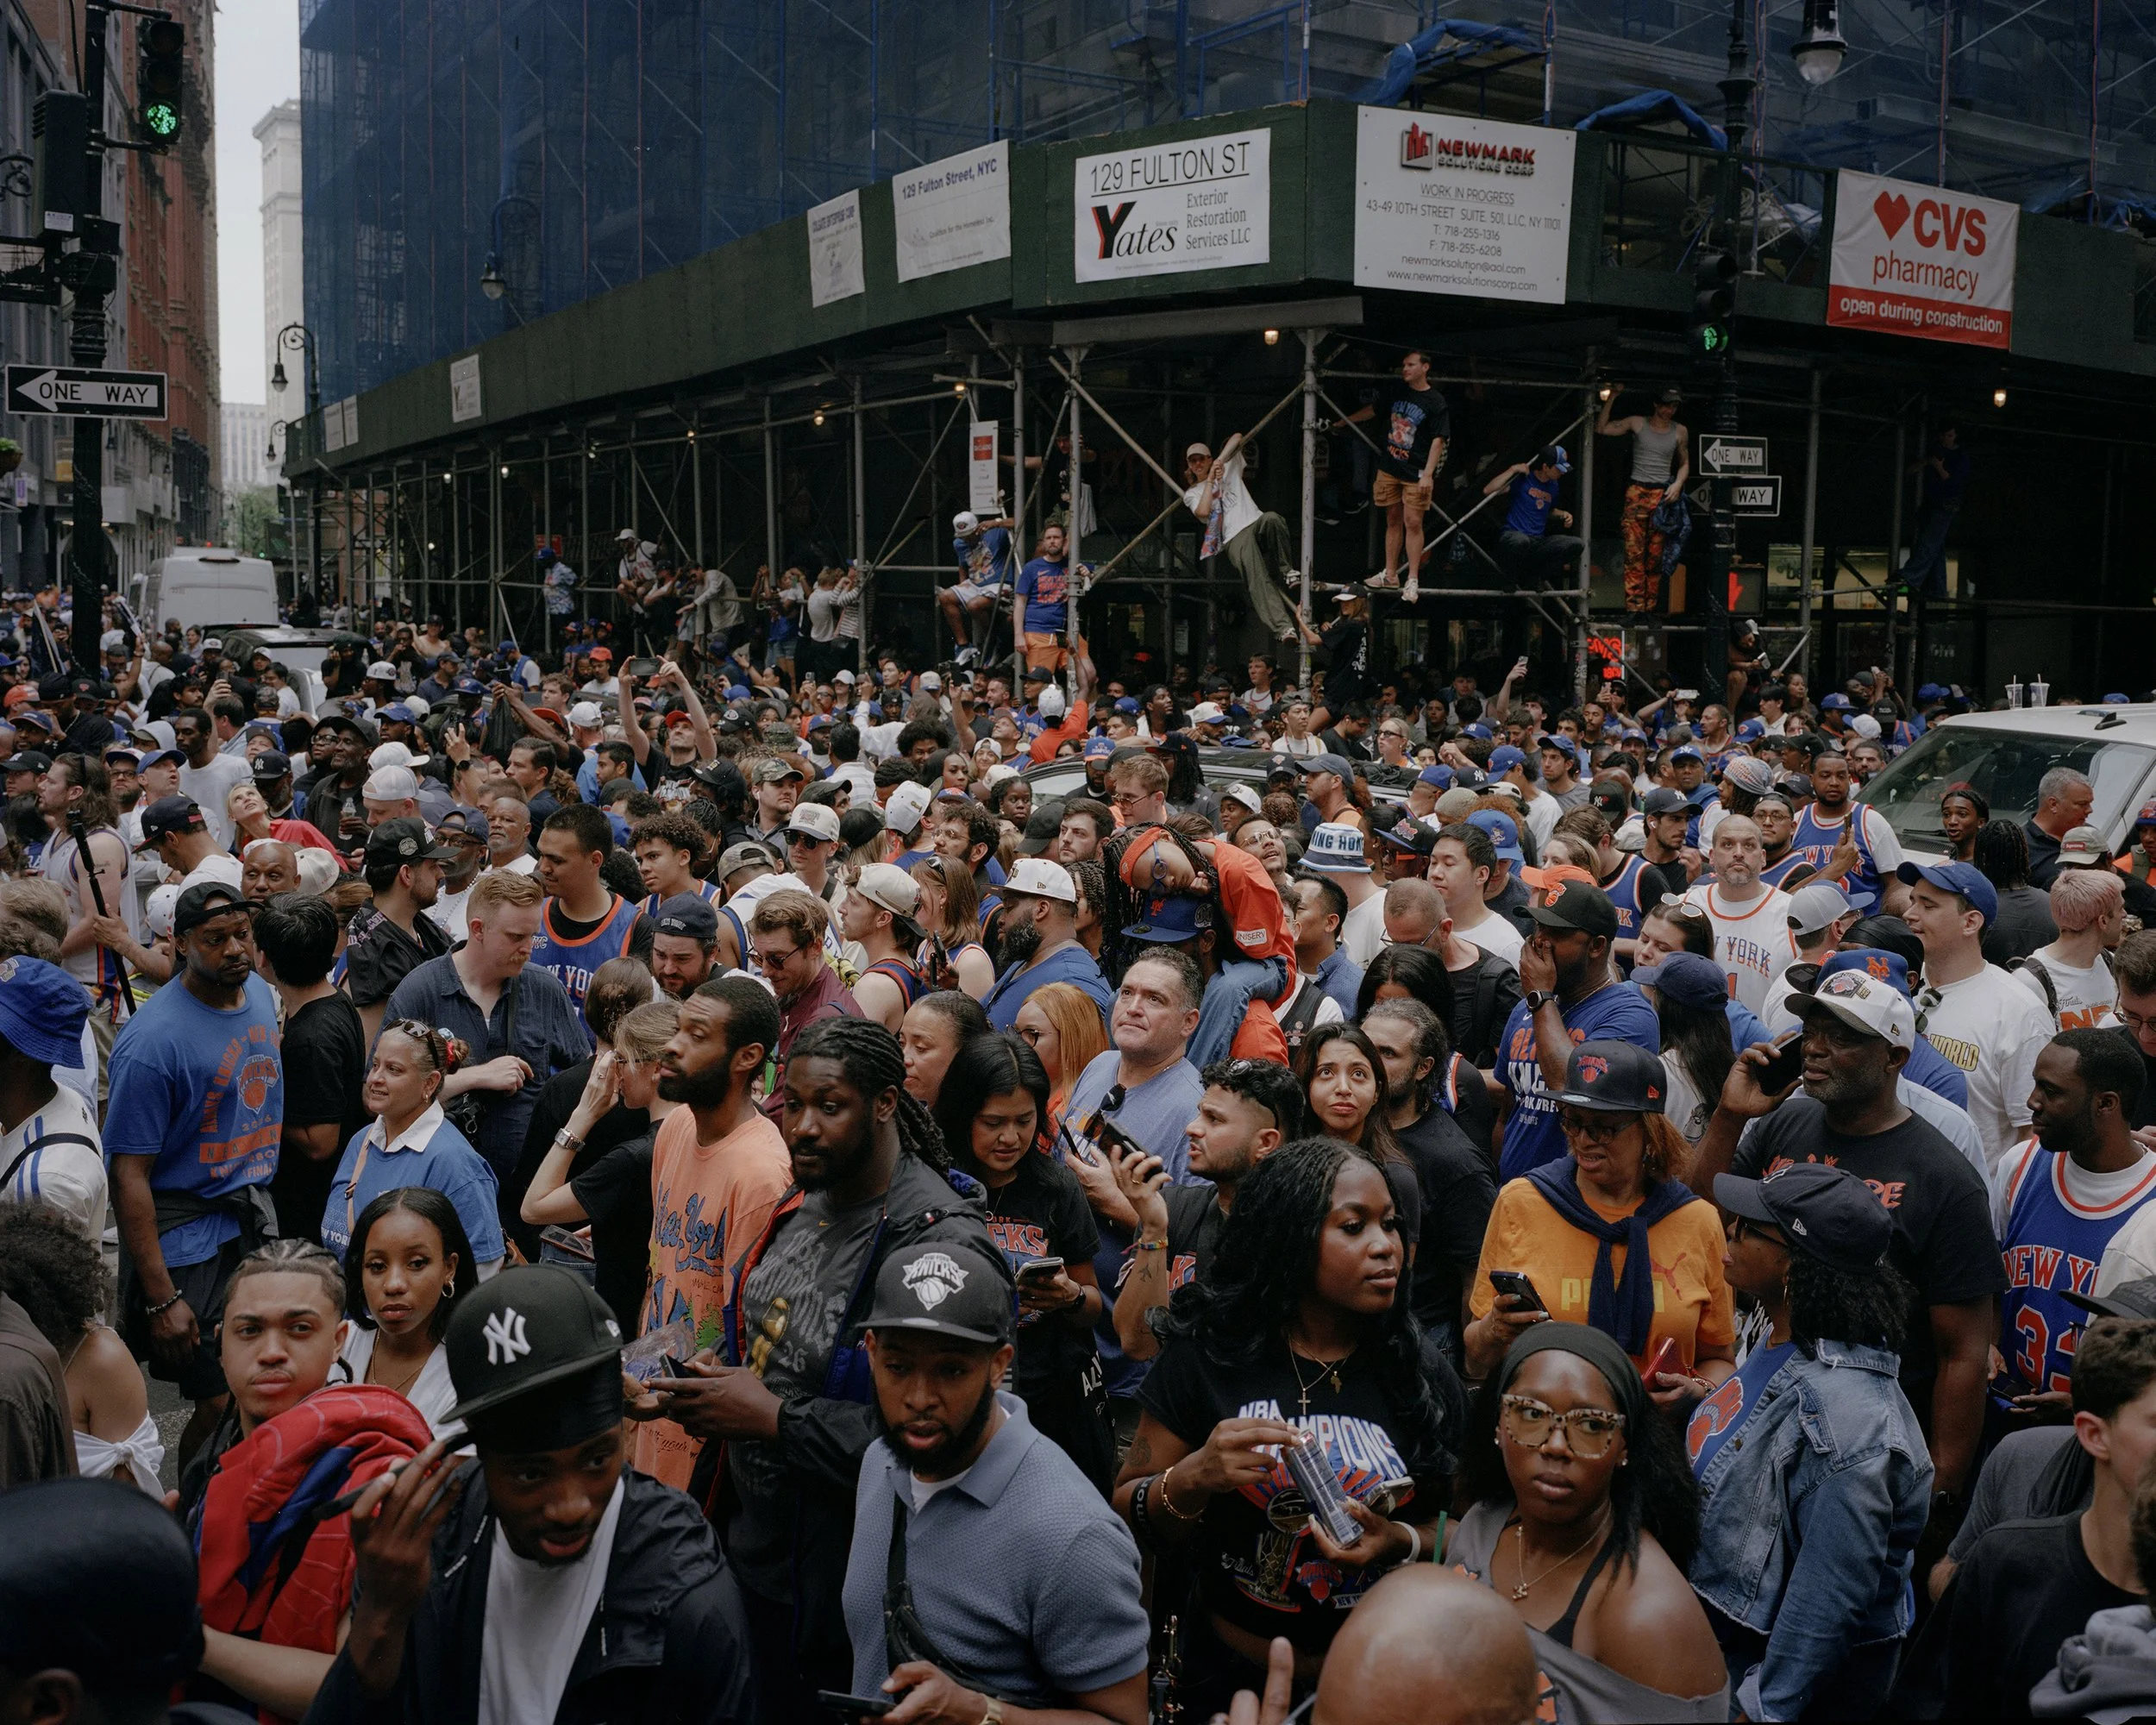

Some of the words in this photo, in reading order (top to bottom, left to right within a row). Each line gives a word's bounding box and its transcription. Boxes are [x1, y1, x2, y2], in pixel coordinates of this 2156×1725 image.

[1438, 138, 1535, 165] NEWMARK
[1091, 161, 1123, 192] 129
[1131, 147, 1214, 187] FULTON
[1222, 141, 1250, 174] ST
[1505, 166, 1535, 178] CORP
[902, 182, 917, 200] 129
[918, 179, 943, 195] Fulton
[945, 166, 975, 186] Street,
[977, 159, 997, 177] NYC
[1187, 189, 1228, 209] Exterior
[1420, 183, 1451, 198] WORK
[1455, 188, 1464, 198] IN
[1466, 188, 1514, 205] PROGRESS
[1187, 207, 1247, 229] Restoration
[1366, 200, 1392, 212] 43-49
[1395, 203, 1418, 215] 10TH
[1420, 204, 1455, 219] STREET
[1528, 219, 1542, 229] NY
[1091, 200, 1178, 260] Yates
[1433, 224, 1441, 235] T:
[1445, 225, 1501, 241] 718-255-1316
[1913, 199, 1987, 256] CVS
[1186, 230, 1228, 250] Services
[1231, 228, 1250, 245] LLC
[1429, 241, 1438, 250] F:
[1440, 241, 1502, 257] 718-255-6208
[1401, 255, 1526, 274] newmarksolution@aol.com
[1873, 250, 1979, 299] pharmacy
[1387, 270, 1538, 292] www.newmarksolutionscorp.com
[1839, 298, 1875, 317] open
[1879, 300, 1922, 326] during
[1926, 310, 2002, 334] construction
[40, 382, 82, 400] ONE
[105, 386, 148, 404] WAY
[1712, 448, 1730, 462] ONE
[1739, 449, 1759, 463] WAY
[1738, 489, 1766, 503] WAY
[254, 758, 264, 770] NY
[1474, 769, 1485, 782] NY
[1594, 795, 1603, 807] NY
[1674, 789, 1688, 801] NY
[1727, 937, 1771, 975] YORK
[987, 1223, 1050, 1258] CKS
[908, 1258, 960, 1285] KNICKS
[2002, 1245, 2065, 1294] NEW
[482, 1307, 531, 1366] NY
[1238, 1399, 1286, 1423] NBA
